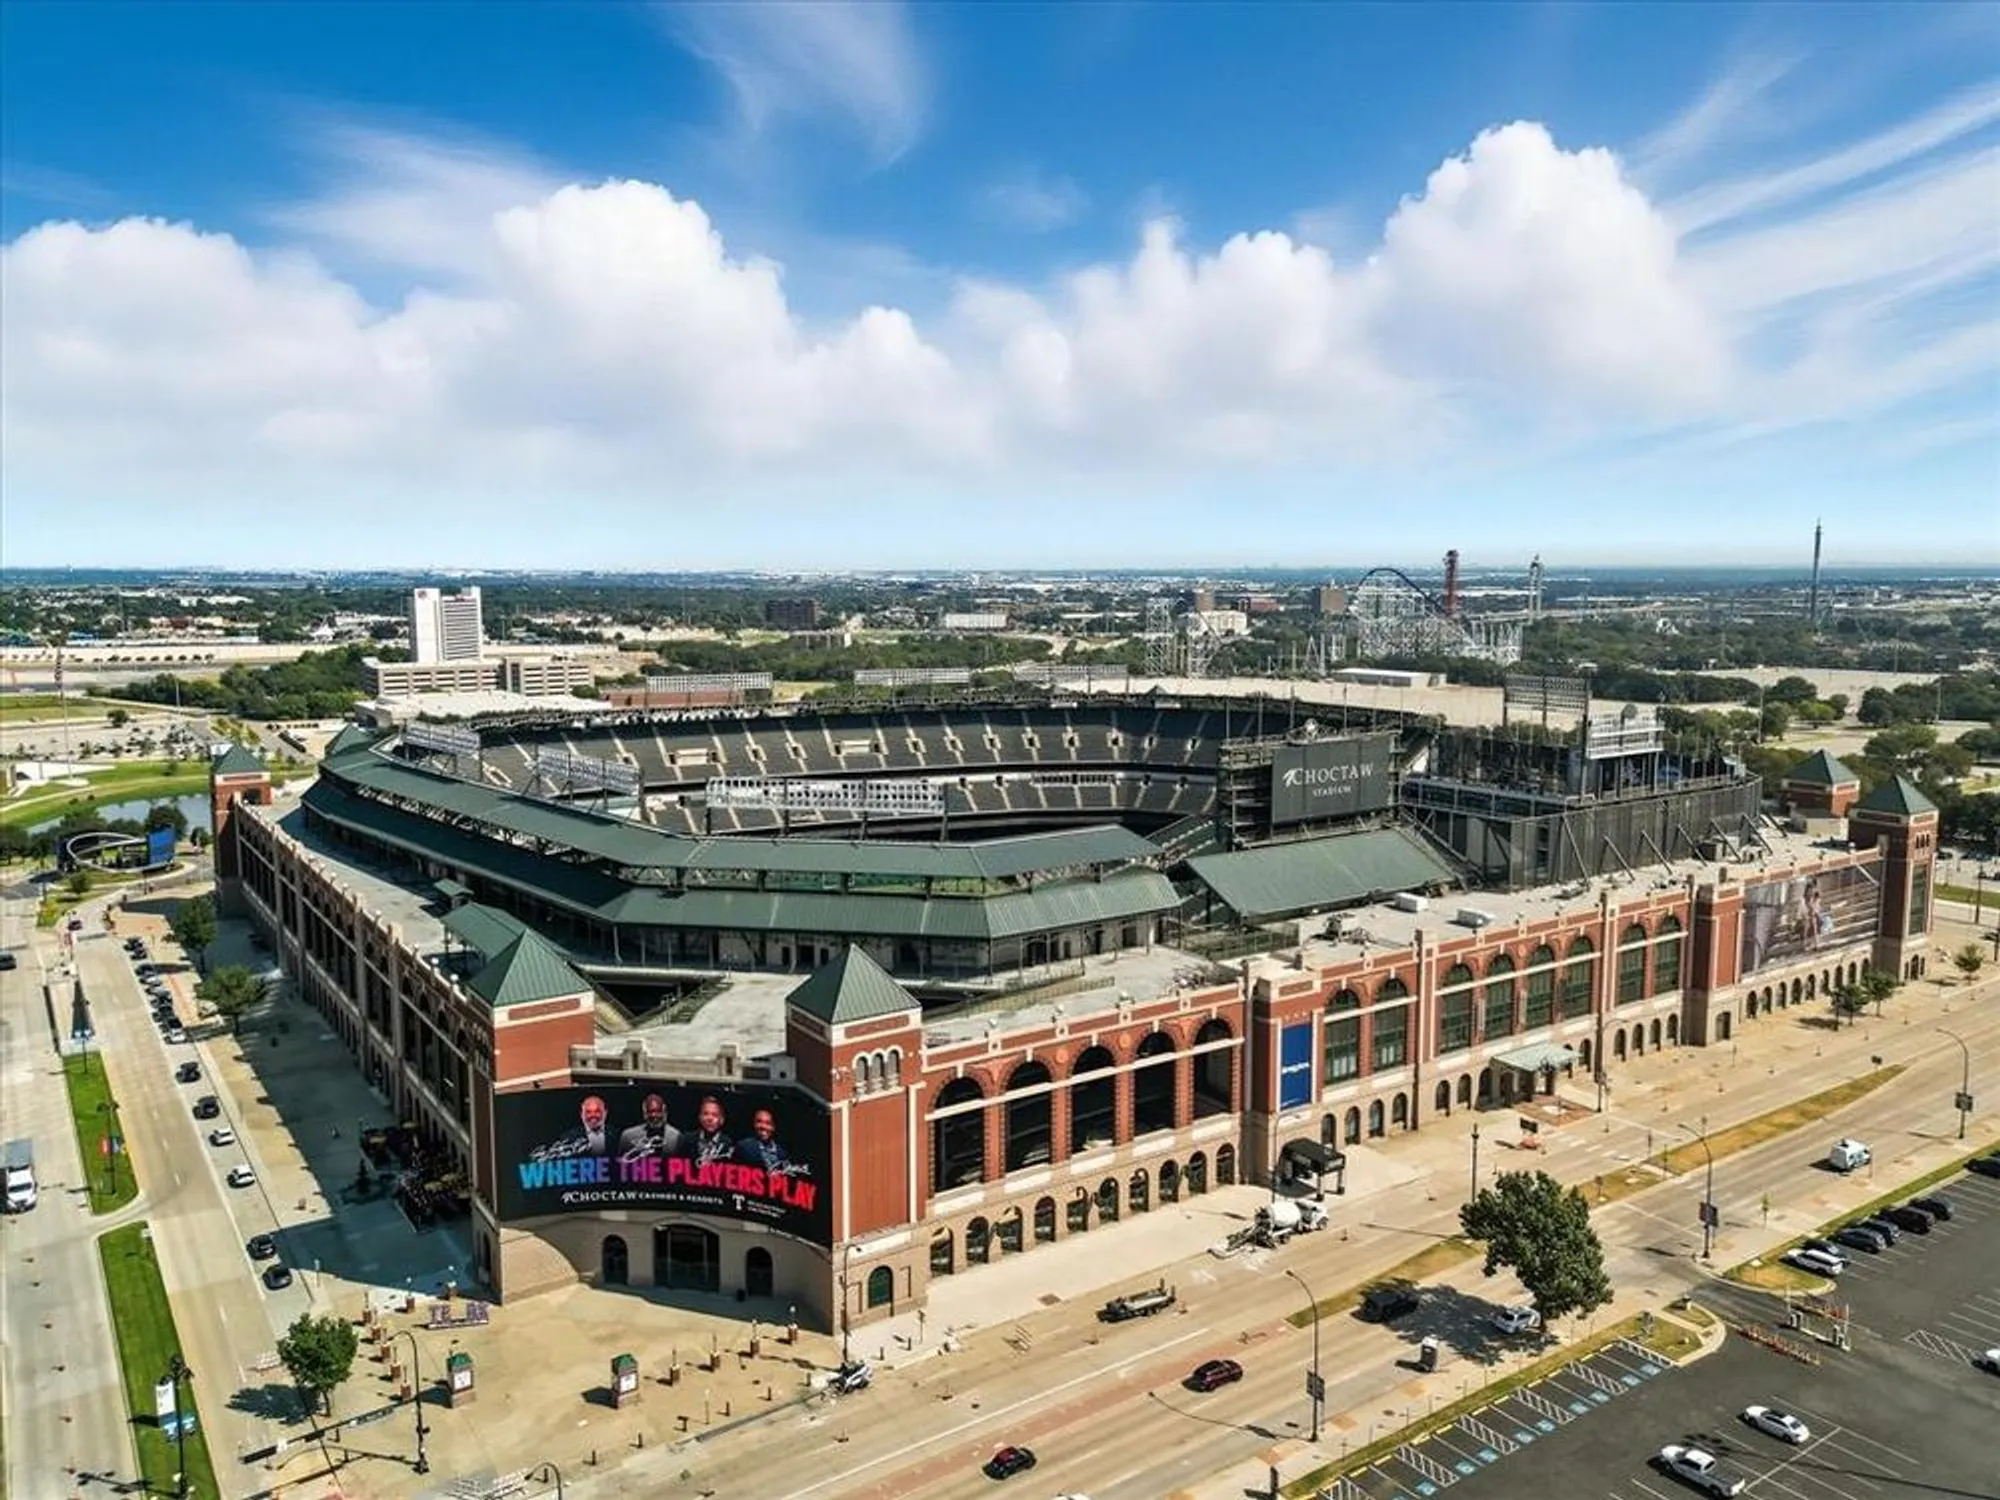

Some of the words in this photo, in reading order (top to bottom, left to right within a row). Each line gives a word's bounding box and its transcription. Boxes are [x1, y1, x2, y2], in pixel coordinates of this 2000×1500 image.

[1293, 762, 1373, 786] CHOCTAW
[1312, 785, 1351, 797] STADIUM
[518, 1156, 611, 1189] WHERE
[616, 1156, 663, 1183] THE
[668, 1157, 765, 1197] PLAYERS
[768, 1173, 816, 1212] PLAY
[570, 1190, 637, 1203] CHOCTAW
